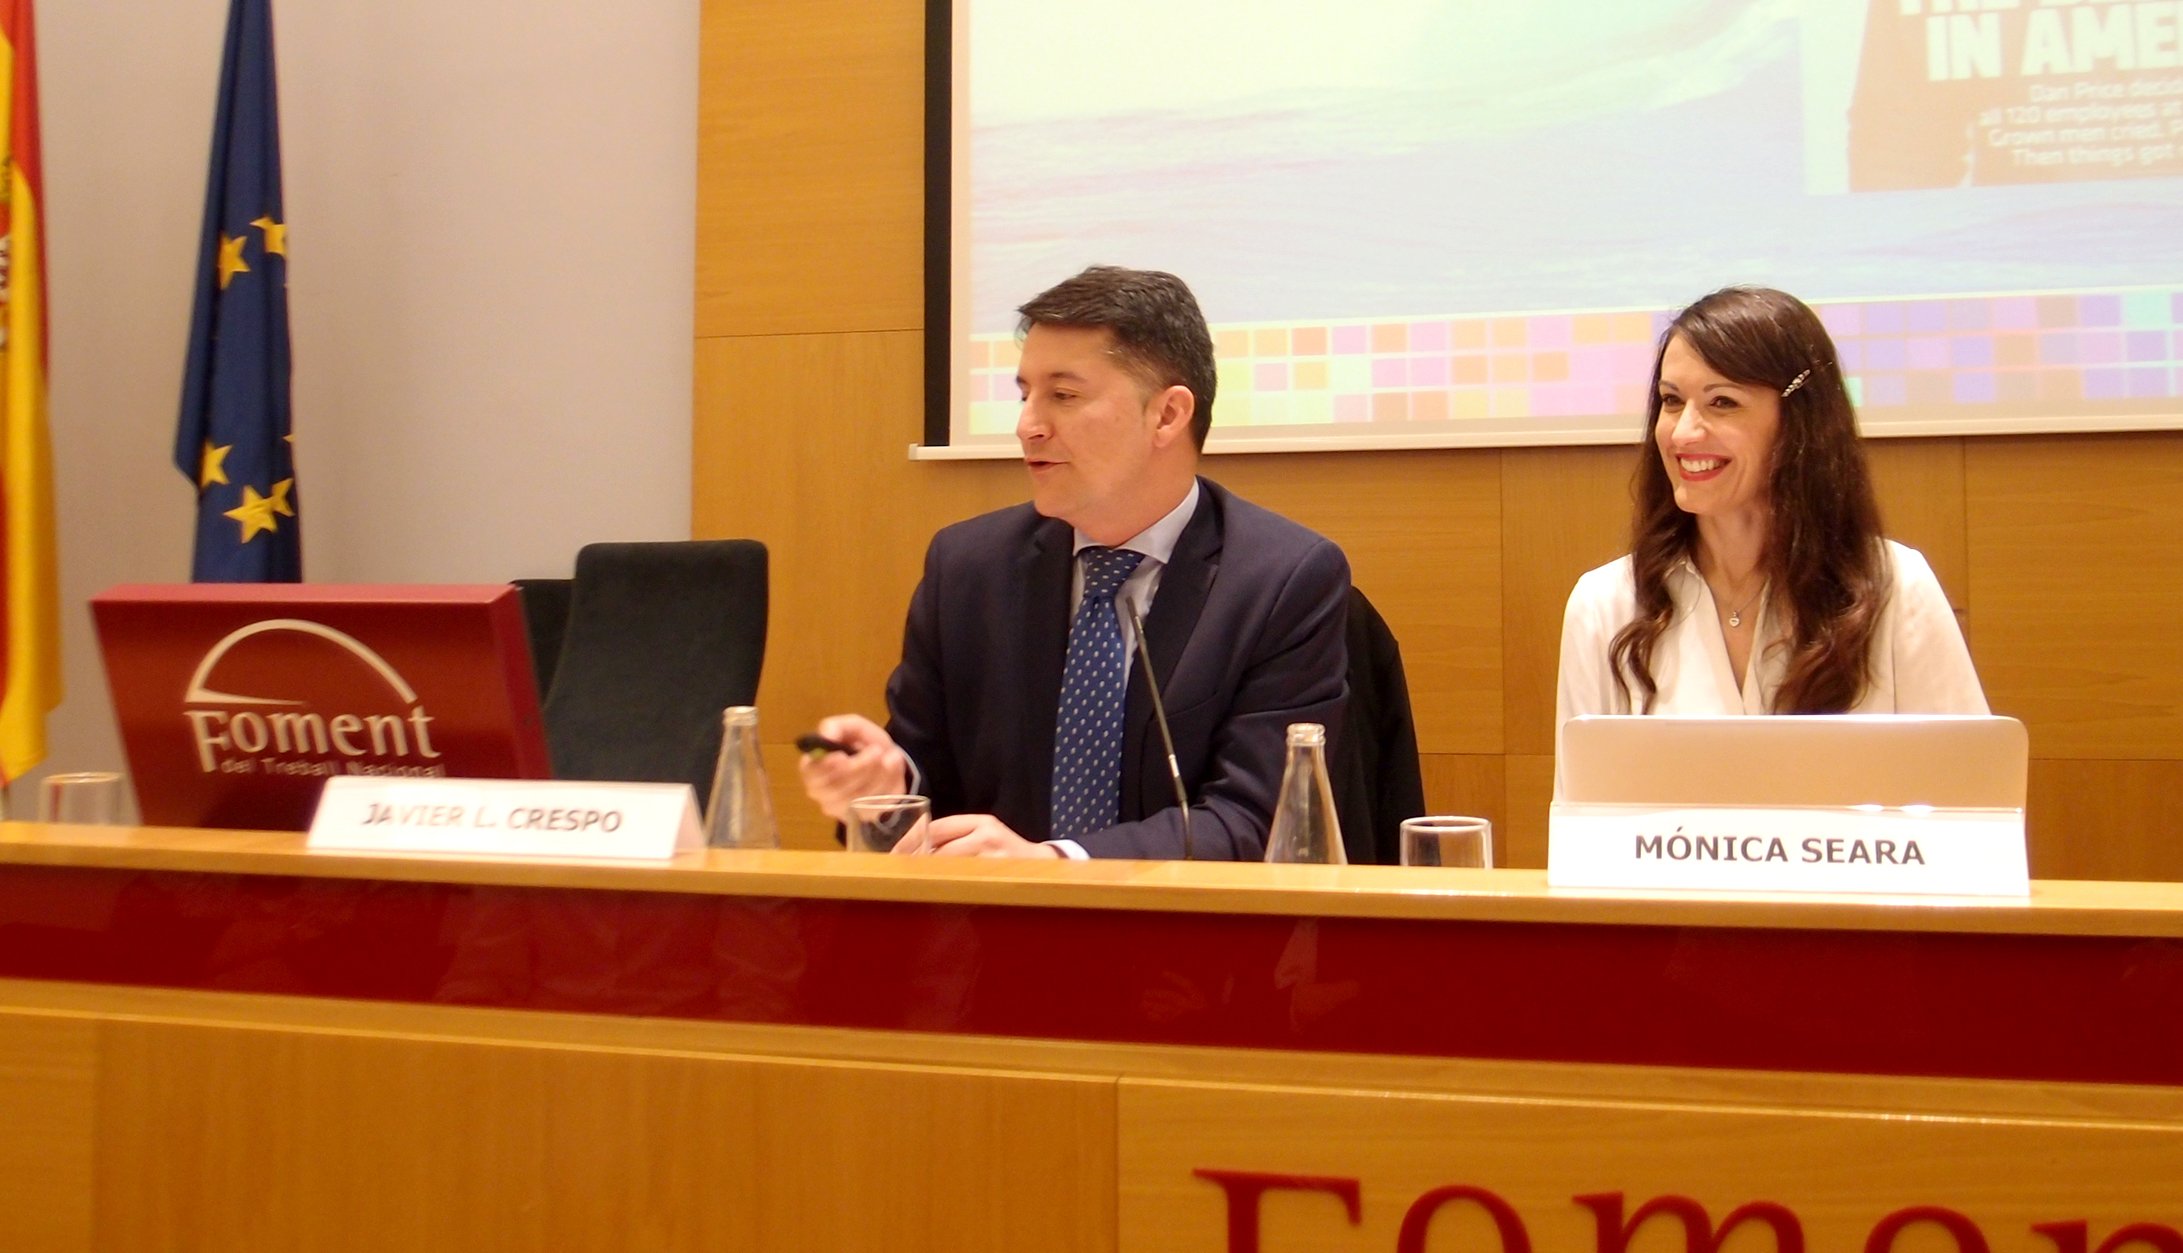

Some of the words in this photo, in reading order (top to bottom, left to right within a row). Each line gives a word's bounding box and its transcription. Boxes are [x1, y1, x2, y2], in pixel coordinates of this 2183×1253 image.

[1926, 12, 2001, 81] IN
[2020, 2, 2183, 76] AME
[183, 704, 442, 773] Foment
[361, 803, 464, 828] JAVIER
[473, 806, 497, 828] L.
[507, 807, 624, 834] CRESPO
[1635, 826, 1789, 863] MÓNICA
[1800, 837, 1926, 865] SEARA
